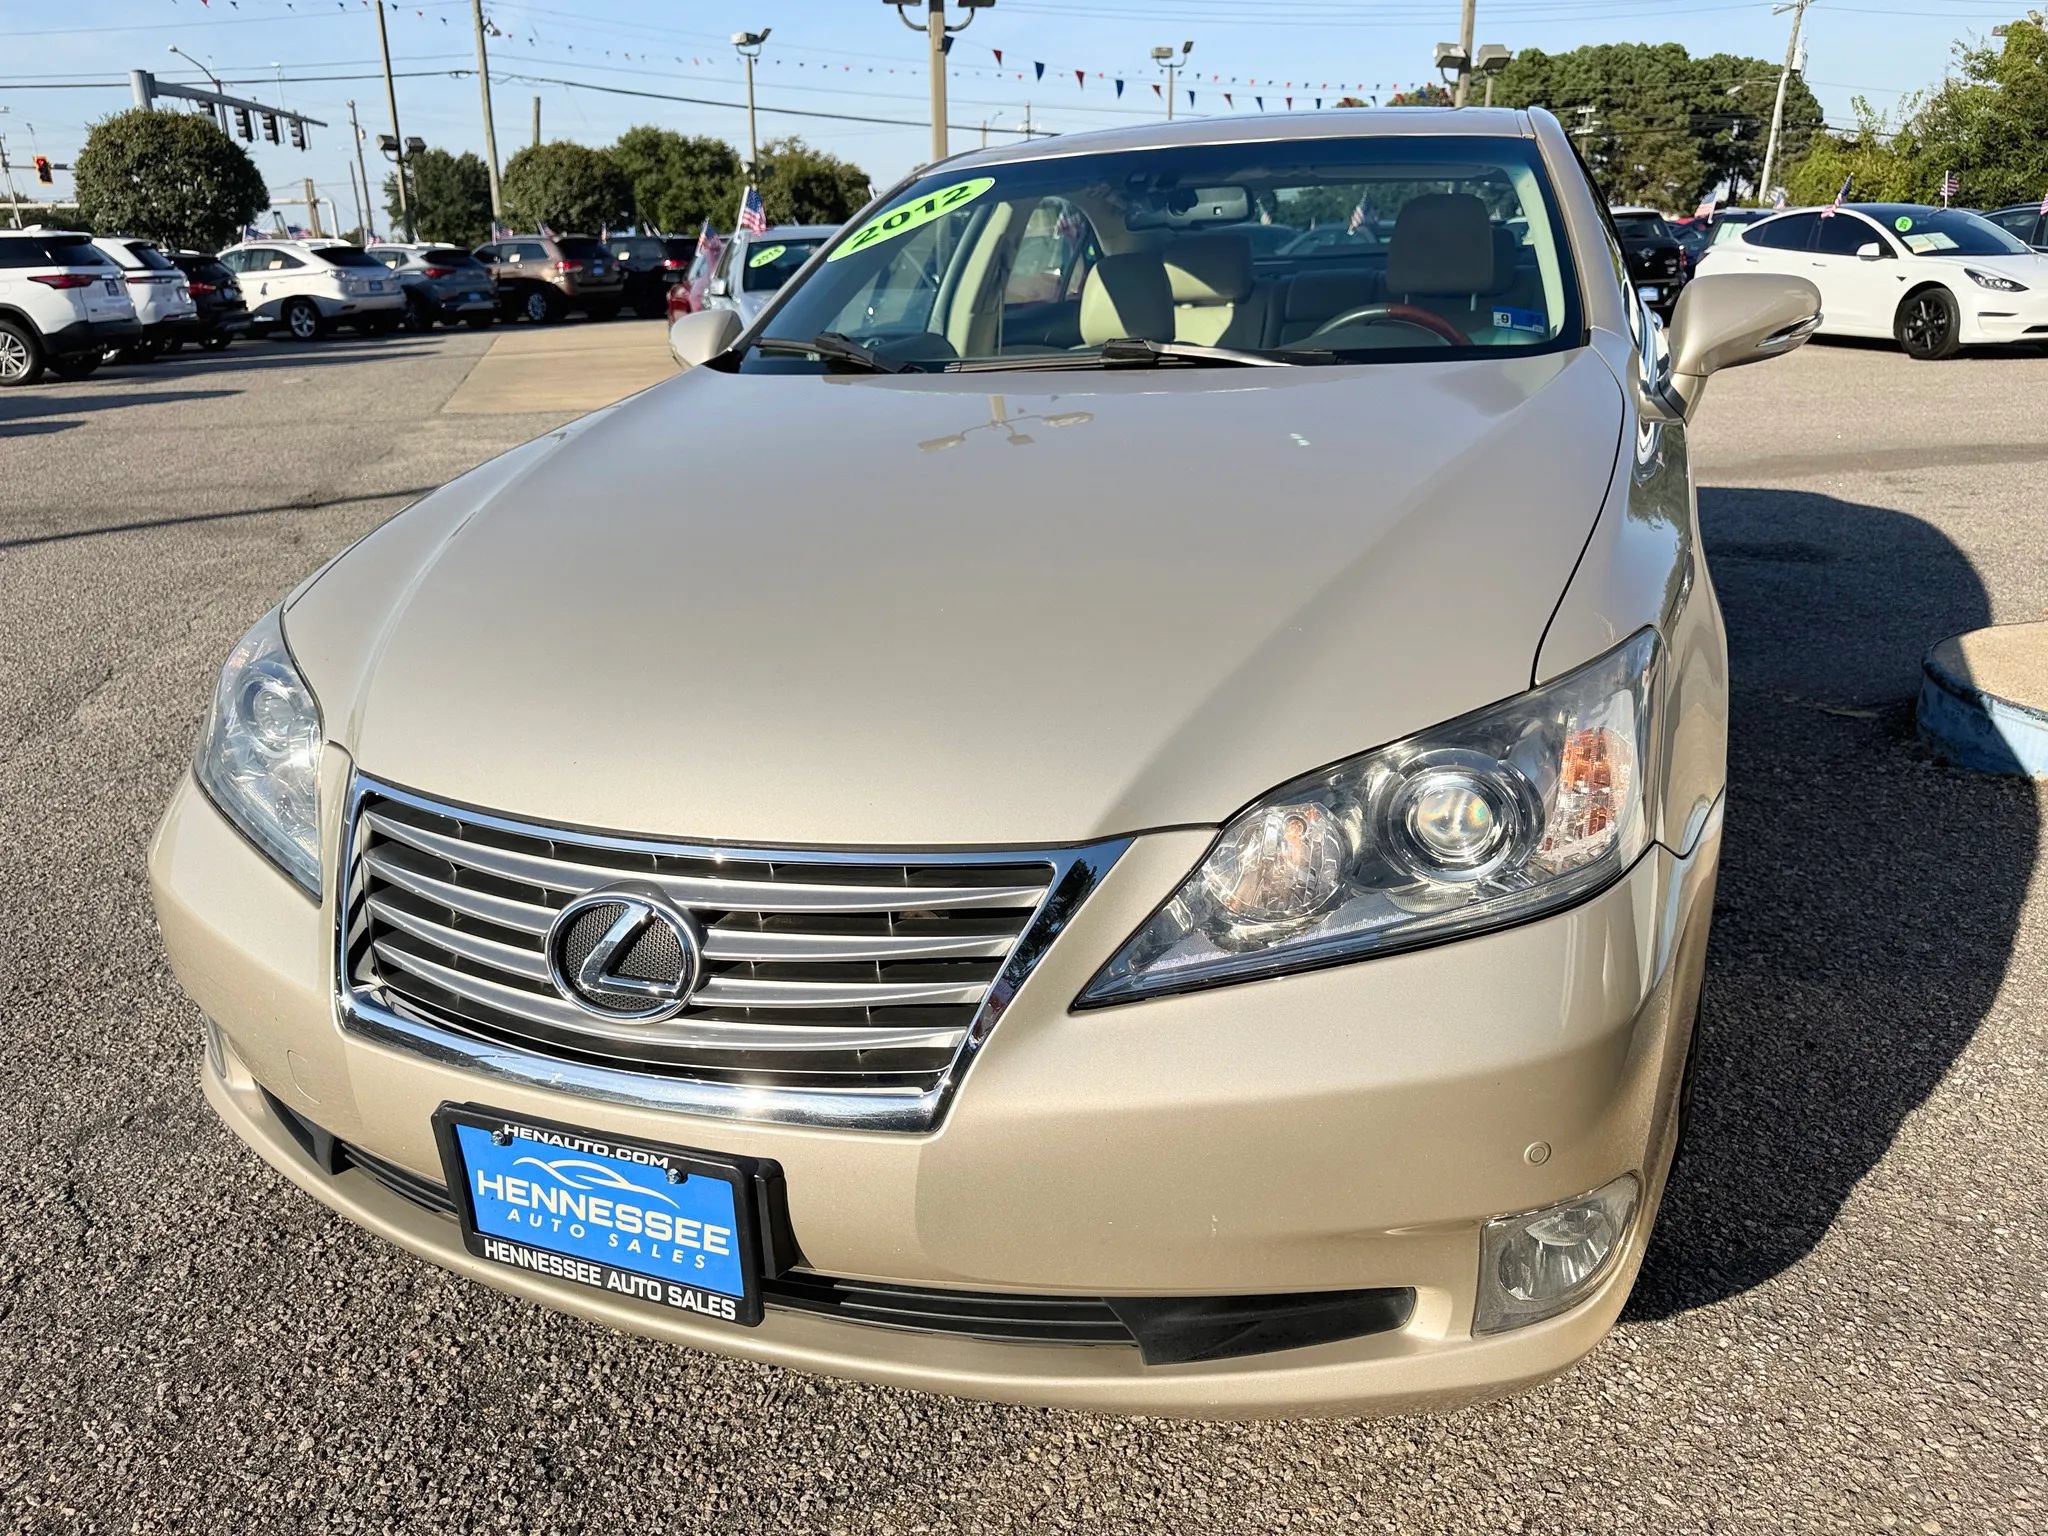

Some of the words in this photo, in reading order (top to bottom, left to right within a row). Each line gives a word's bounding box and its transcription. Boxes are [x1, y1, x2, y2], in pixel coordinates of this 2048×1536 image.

[852, 185, 972, 249] 2012
[1501, 313, 1509, 324] 9
[503, 1123, 669, 1169] HENAUTO.COM
[477, 1169, 730, 1256] HENNESSEE
[507, 1208, 585, 1238] AUTO
[608, 1232, 706, 1270] SALES
[484, 1239, 602, 1287] HENNESSEE
[606, 1271, 663, 1302] AUTO
[667, 1286, 736, 1321] SALES
